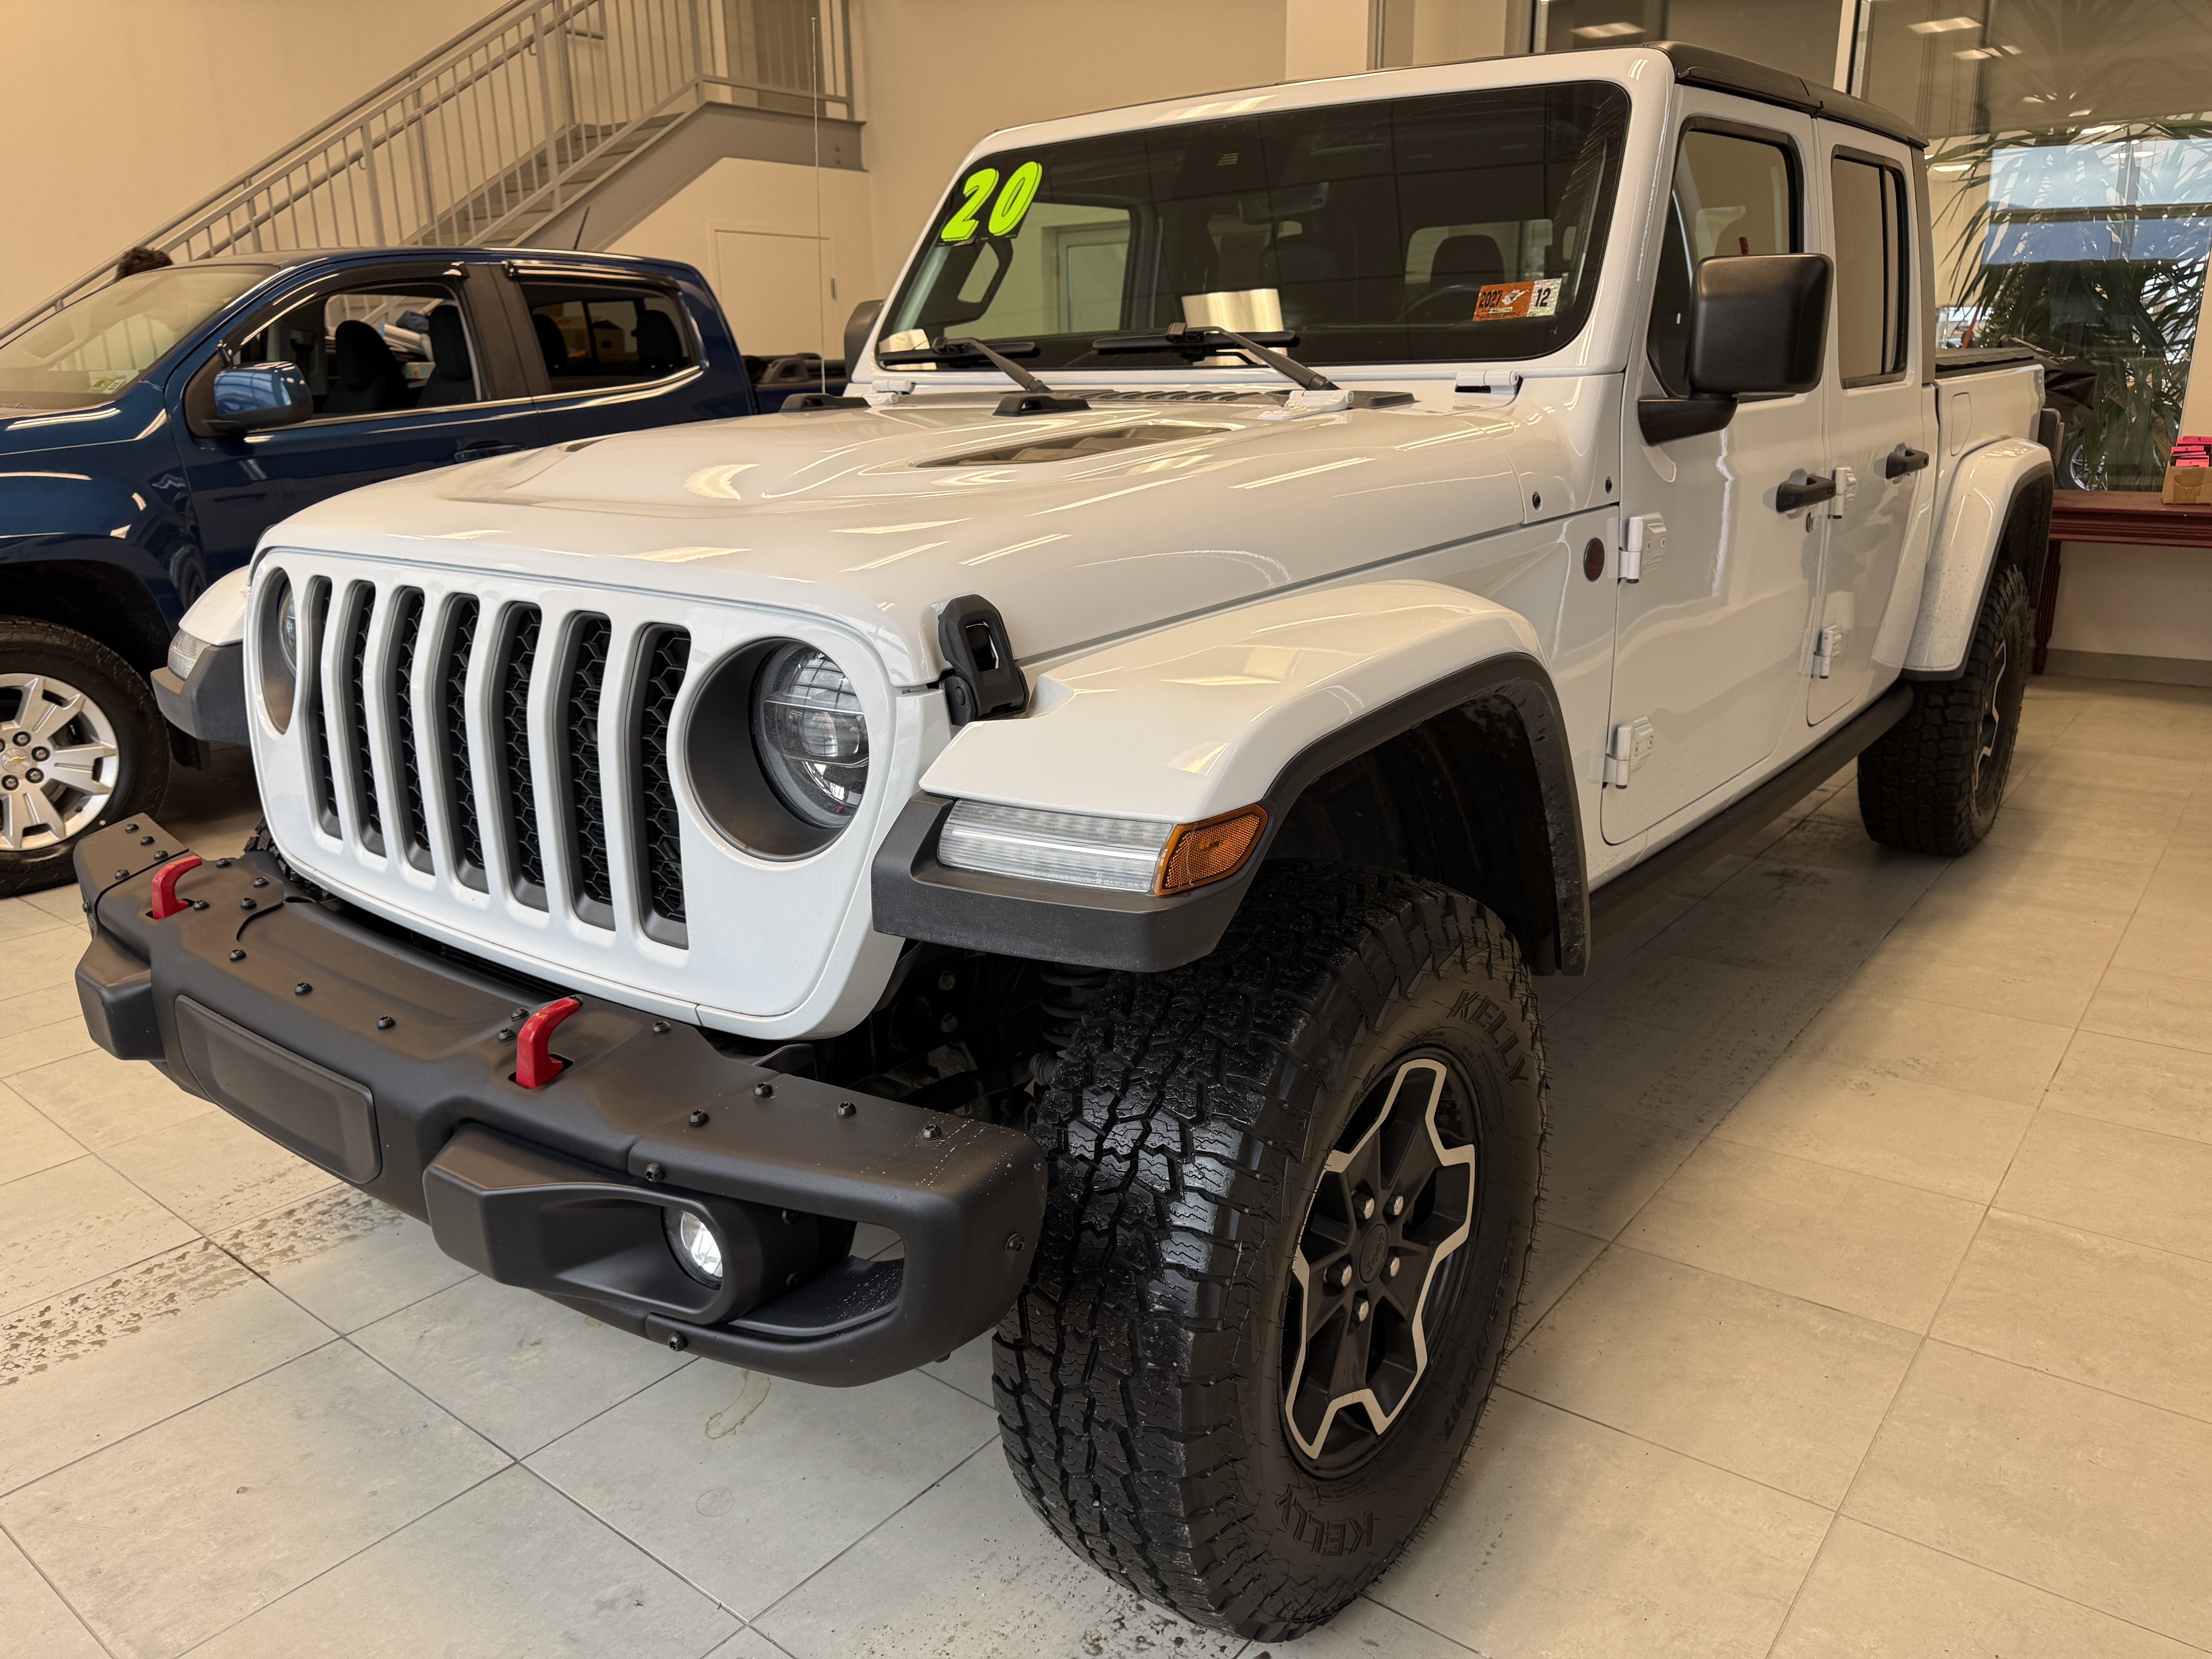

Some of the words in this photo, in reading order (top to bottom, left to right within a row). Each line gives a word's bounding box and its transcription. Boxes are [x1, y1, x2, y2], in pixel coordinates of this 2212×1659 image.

[941, 161, 1042, 241] 20
[1479, 290, 1503, 308] 2027
[1535, 289, 1551, 307] 12
[1446, 989, 1529, 1084] KELLY
[1275, 1484, 1373, 1557] KELLY
